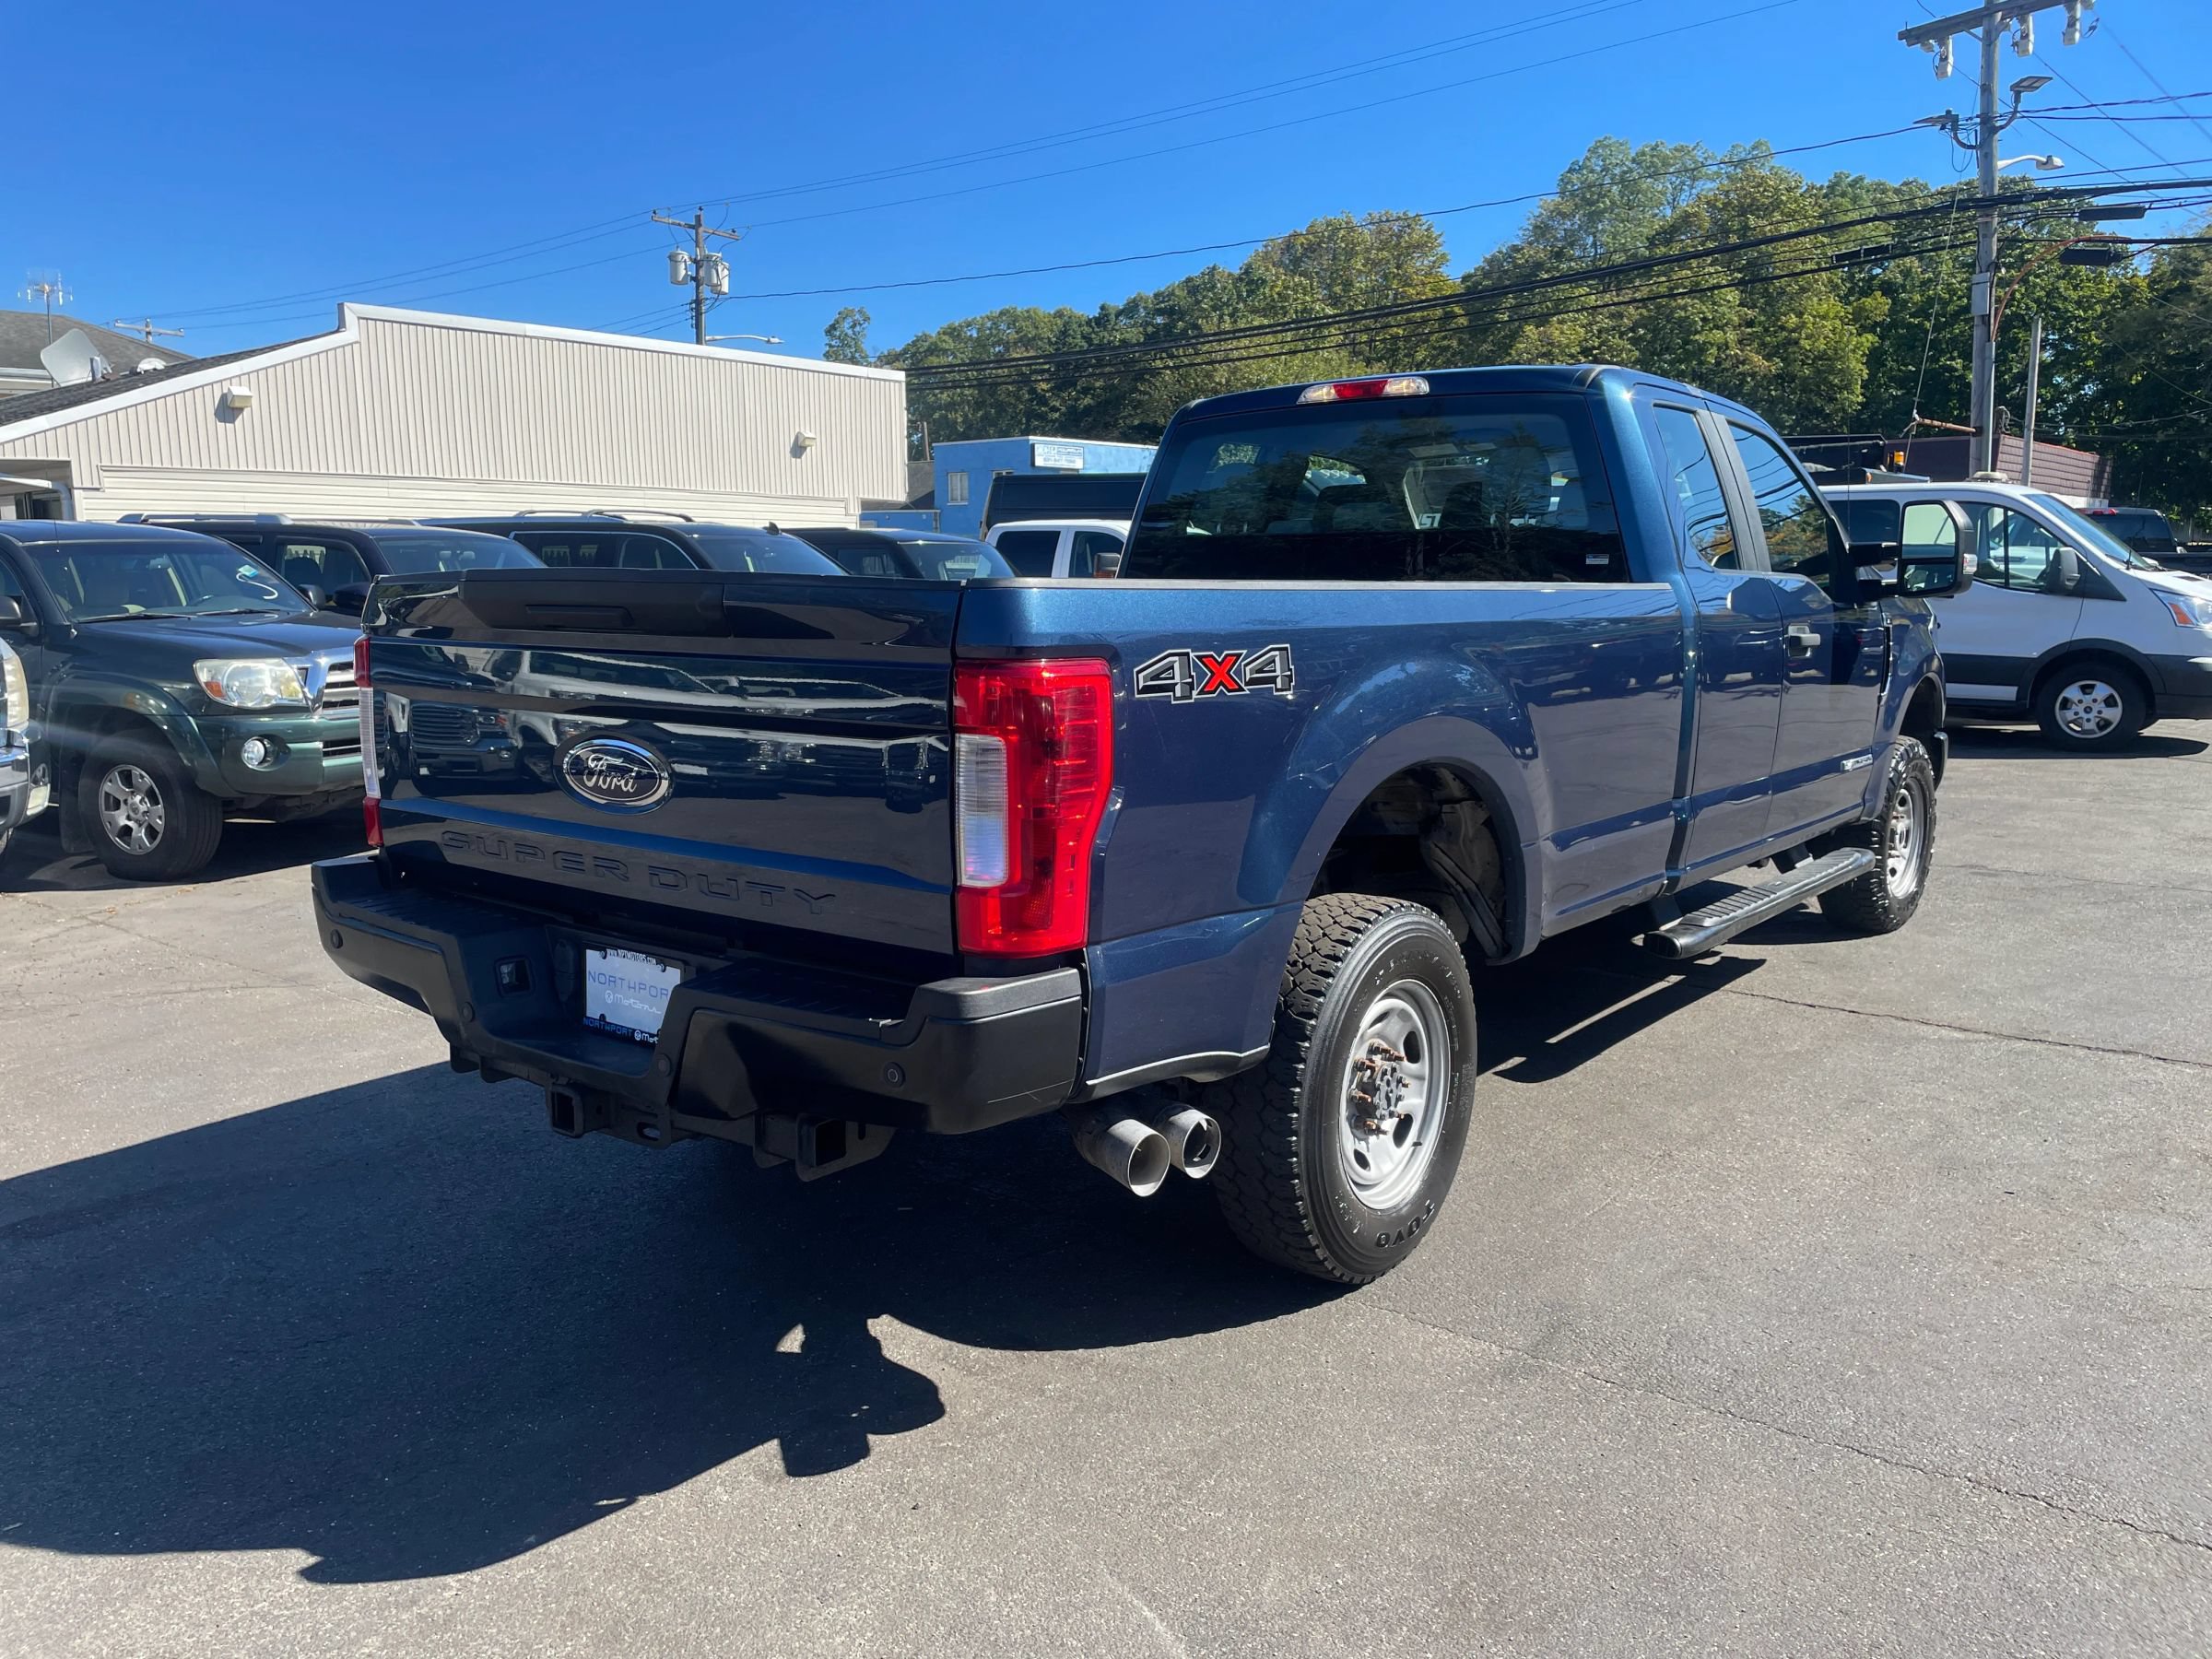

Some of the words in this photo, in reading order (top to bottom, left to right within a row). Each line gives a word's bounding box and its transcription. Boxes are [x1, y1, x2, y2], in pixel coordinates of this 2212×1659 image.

[583, 754, 645, 793] Ford
[442, 830, 629, 882] SUPER
[648, 865, 835, 915] DUTY
[588, 970, 670, 1000] NORTHPOR
[583, 1017, 633, 1038] NORTHPORT
[642, 1033, 659, 1044] Mot
[1375, 1199, 1435, 1248] TOYO
